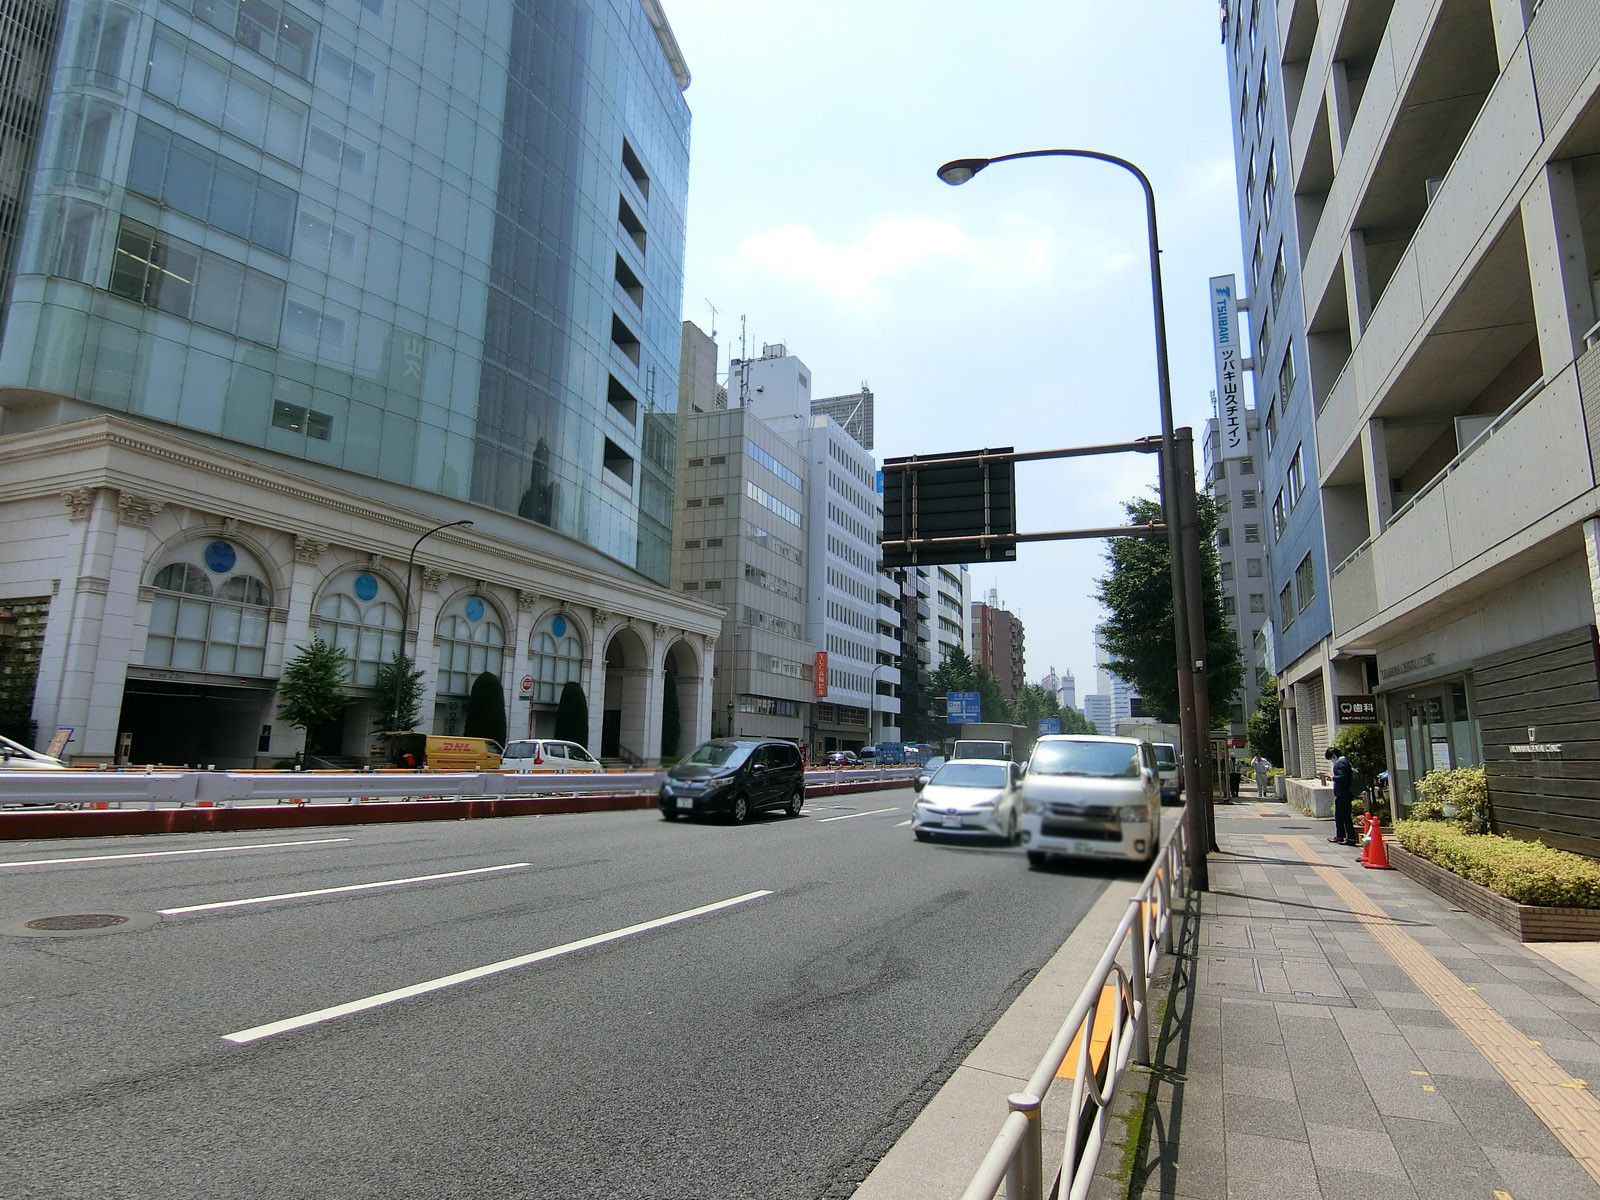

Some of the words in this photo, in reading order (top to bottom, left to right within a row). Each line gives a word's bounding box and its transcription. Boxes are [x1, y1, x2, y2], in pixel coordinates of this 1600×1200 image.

[1217, 299, 1229, 343] TSUBAKI
[1223, 350, 1240, 448] ツバキ山久チエイン
[1353, 702, 1374, 713] 歯科
